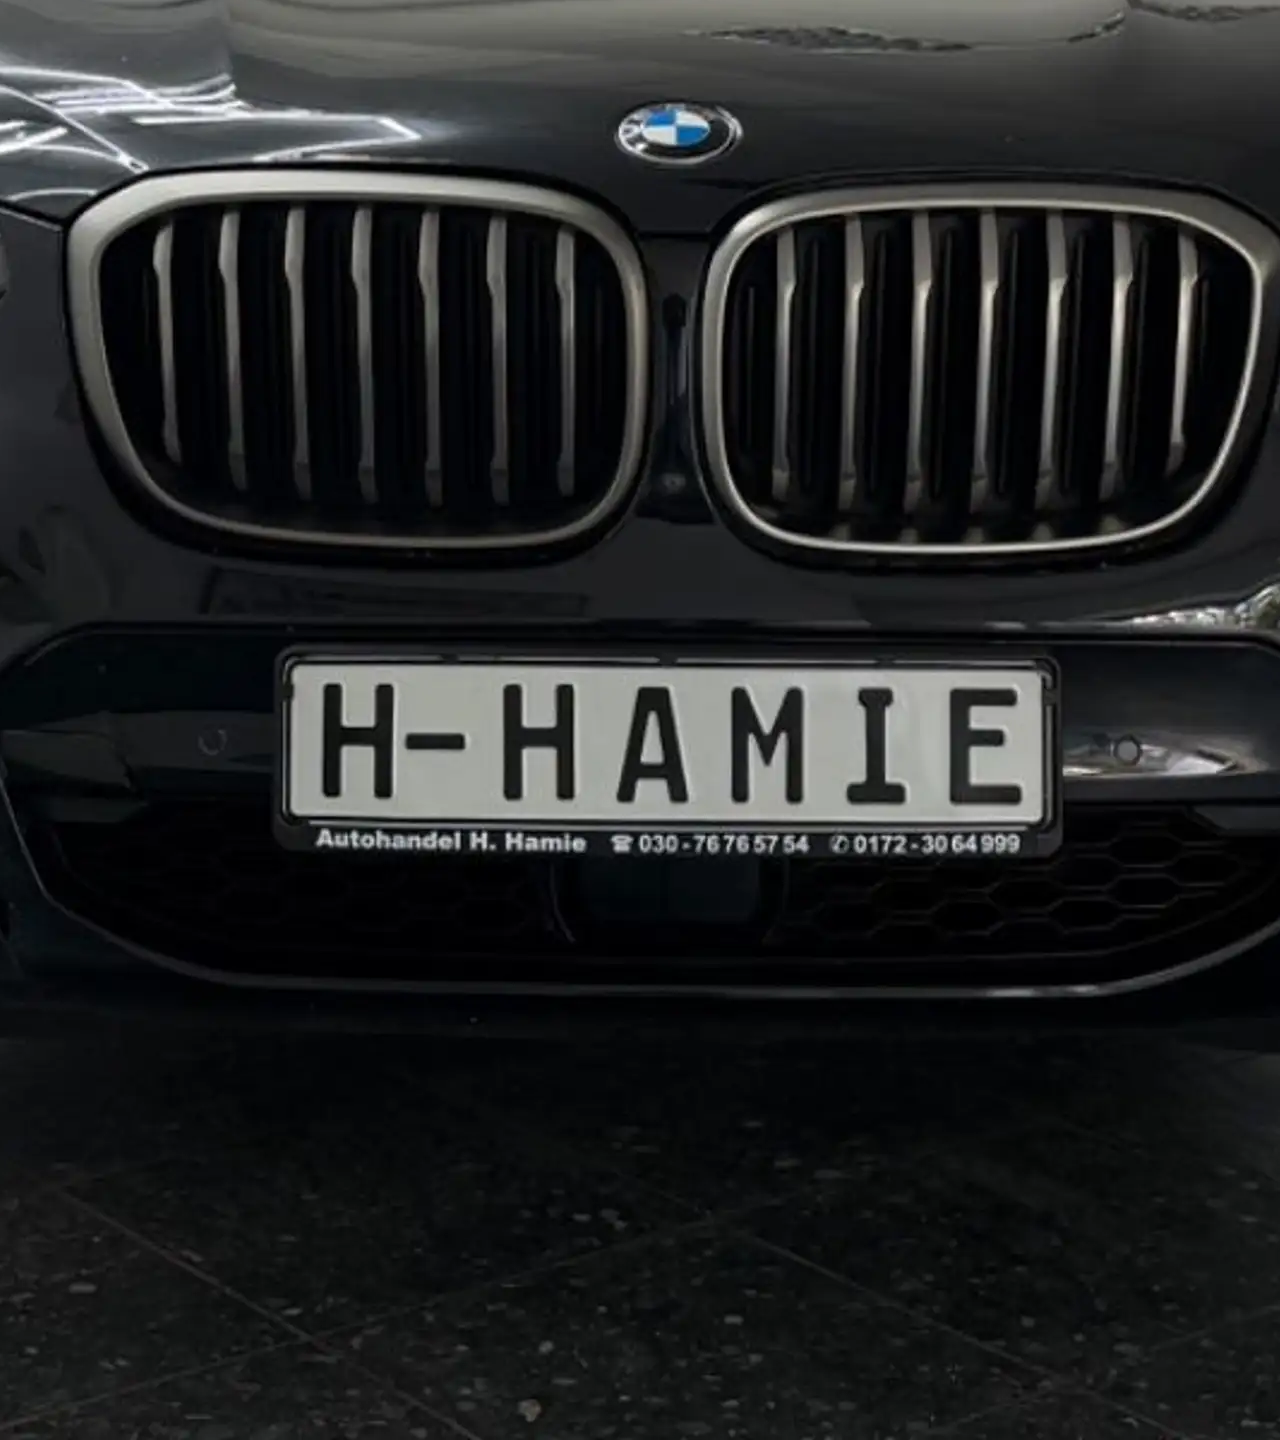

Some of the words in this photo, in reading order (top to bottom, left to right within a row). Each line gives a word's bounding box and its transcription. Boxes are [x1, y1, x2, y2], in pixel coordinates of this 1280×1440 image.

[322, 683, 1023, 804] H-HAMIE
[316, 828, 462, 850] Autohandel
[470, 831, 498, 851] H.
[504, 832, 588, 853] Hamie
